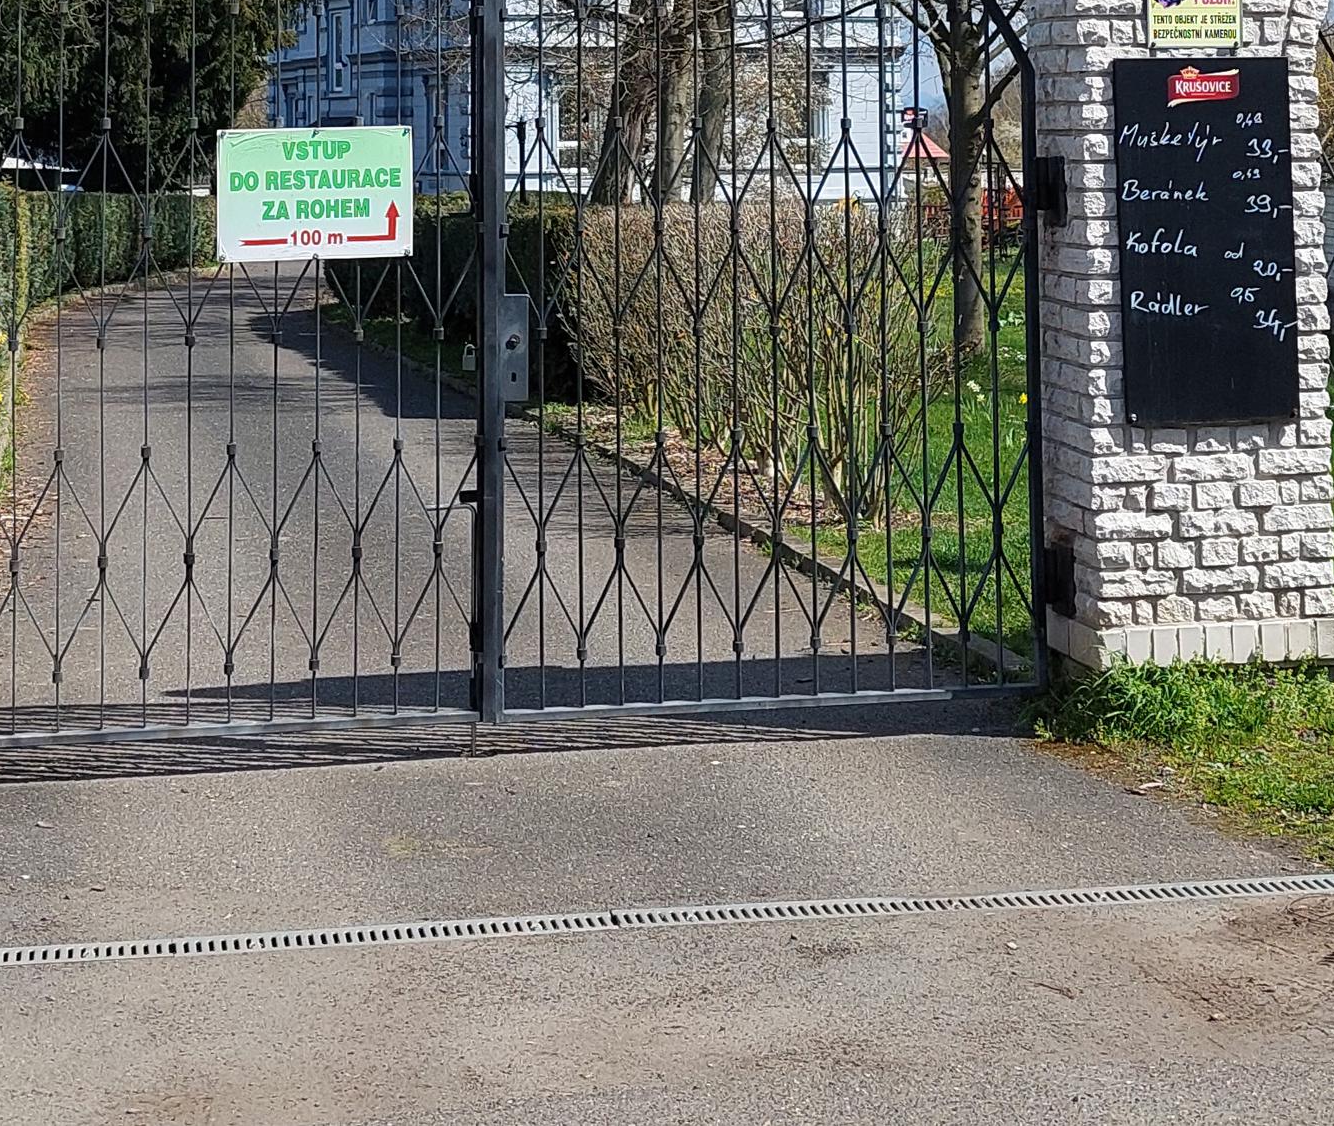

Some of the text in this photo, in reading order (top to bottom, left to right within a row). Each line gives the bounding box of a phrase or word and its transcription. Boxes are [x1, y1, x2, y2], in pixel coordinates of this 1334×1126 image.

[1153, 12, 1236, 24] TENTO OBJEKT JE STŘEŽEN
[1153, 26, 1237, 39] BEZPEČNOSTNÍ KAMEROU
[1175, 78, 1232, 96] KRUŠOVICE
[282, 141, 351, 161] VSTUP
[229, 168, 402, 191] DO RESTAURACE
[1121, 180, 1209, 201] Beránek
[262, 198, 370, 220] ZA ROHEM
[290, 230, 343, 246] 100 m
[1126, 228, 1245, 260] Kofola od
[1130, 290, 1210, 316] Rádler
